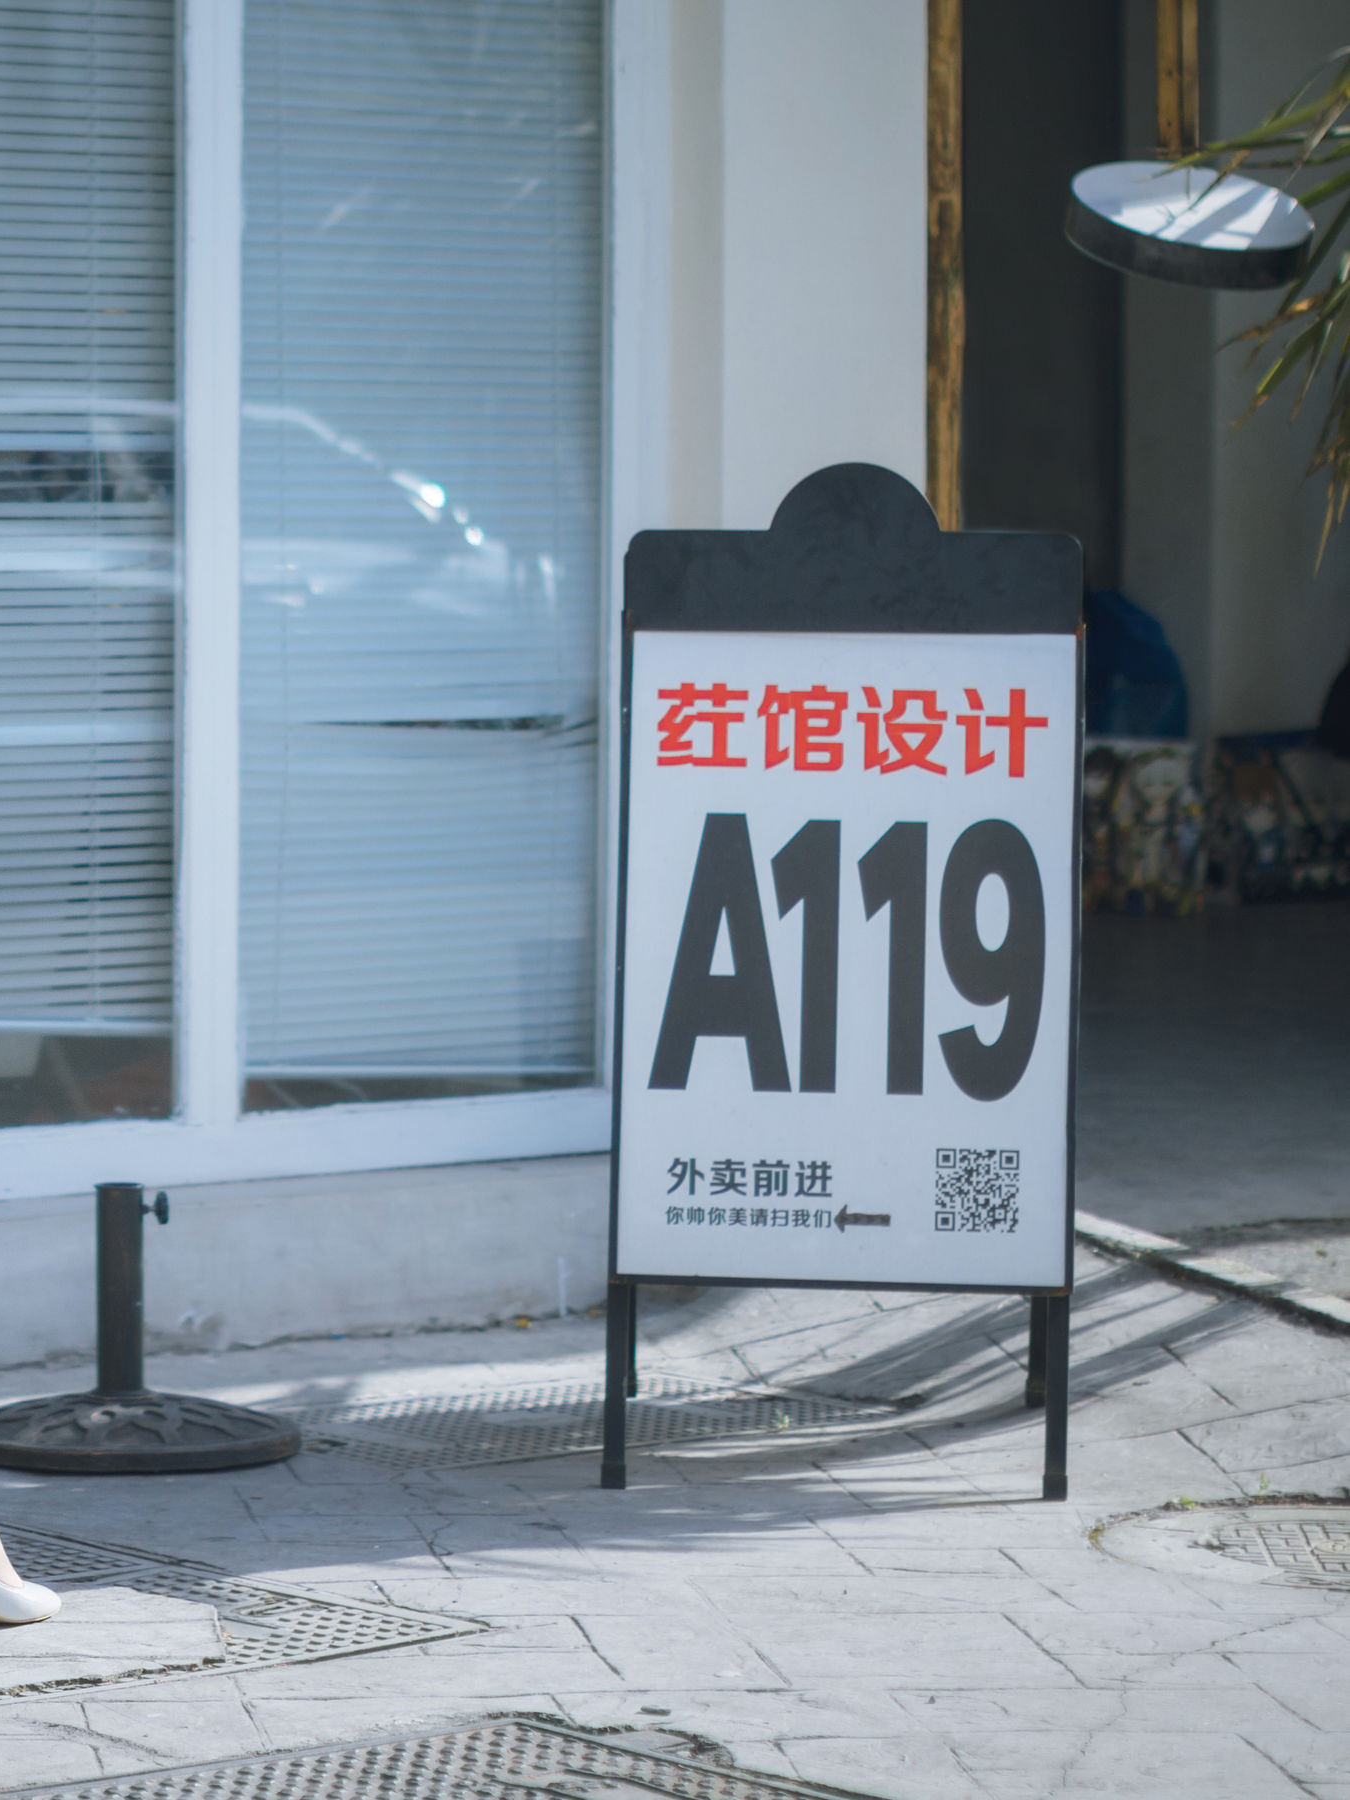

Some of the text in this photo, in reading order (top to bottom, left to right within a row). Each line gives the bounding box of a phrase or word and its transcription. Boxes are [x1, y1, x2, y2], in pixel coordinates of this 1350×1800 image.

[647, 812, 1046, 1102] A119
[667, 1158, 832, 1197] 外卖前进
[665, 1206, 831, 1228] 你帅你美请扫我们
